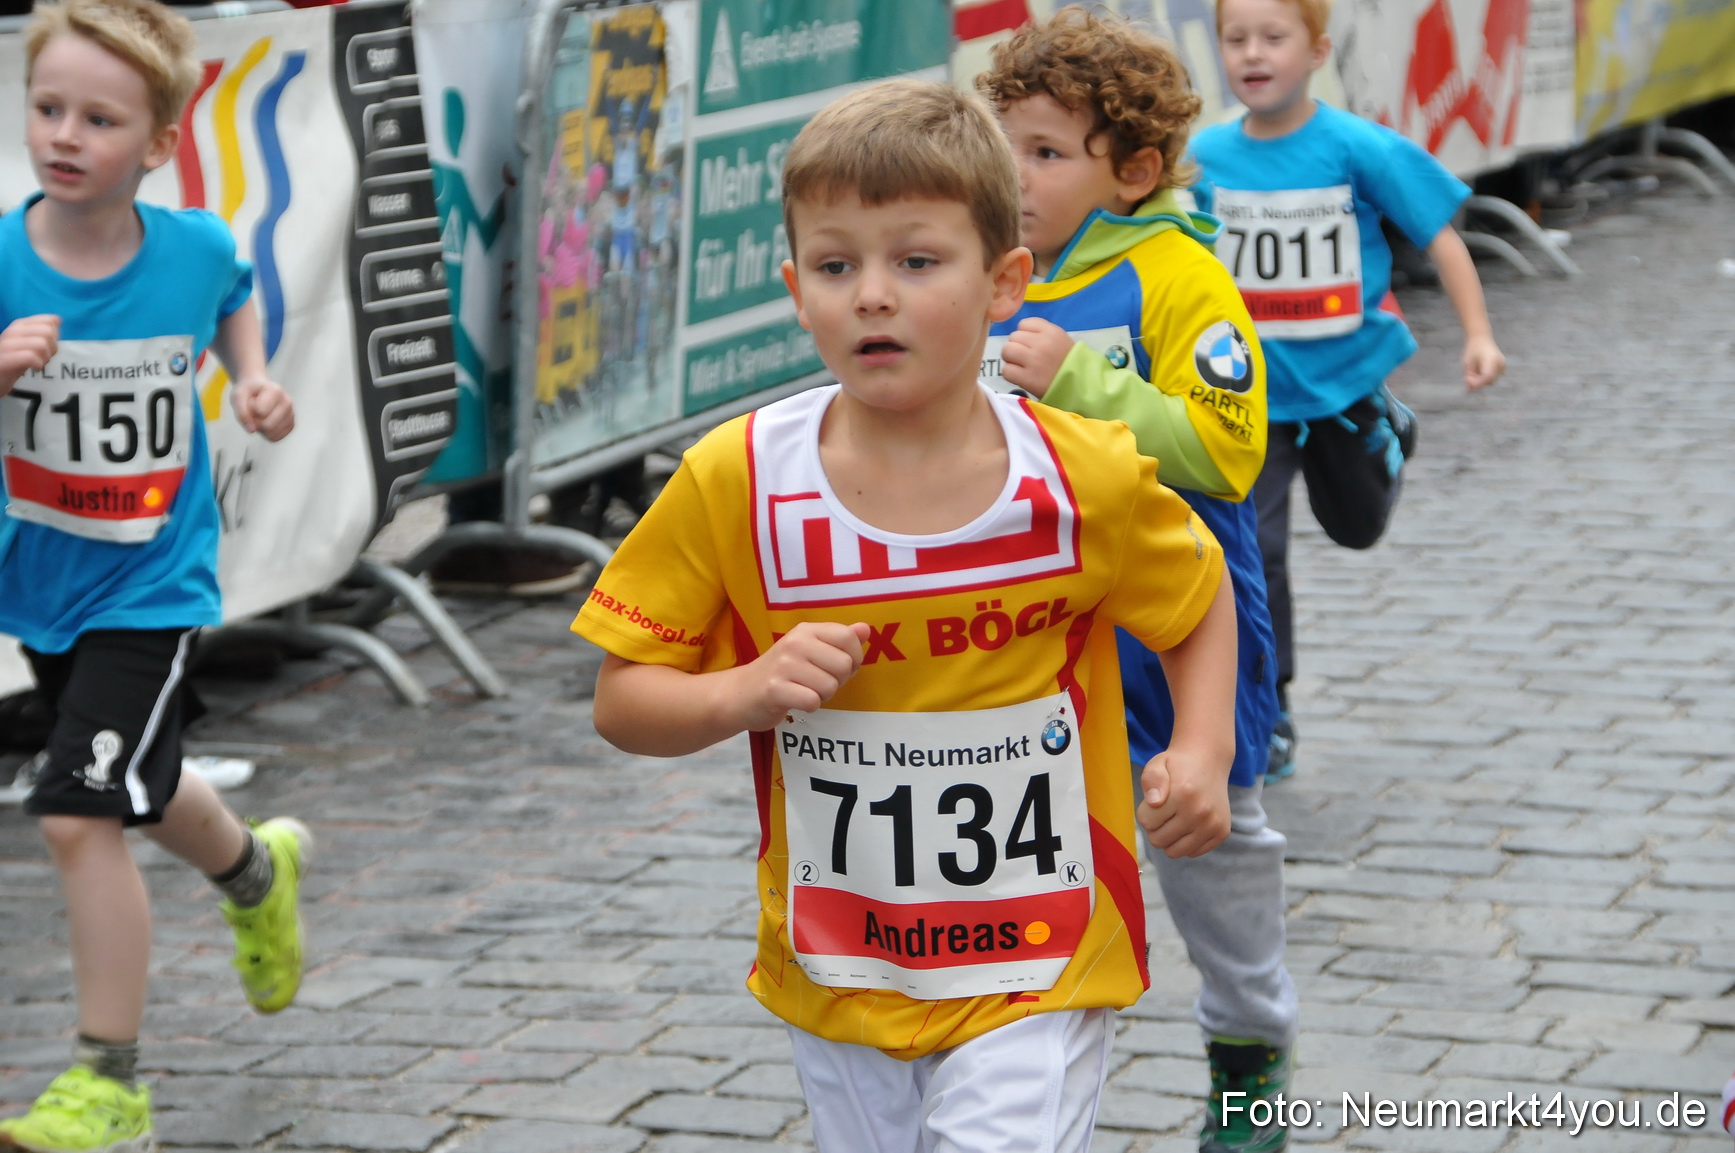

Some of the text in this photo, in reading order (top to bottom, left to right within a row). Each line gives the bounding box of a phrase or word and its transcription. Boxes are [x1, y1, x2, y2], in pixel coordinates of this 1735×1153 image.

[699, 147, 763, 216] Mehr
[1262, 203, 1336, 219] Neumarkt
[695, 238, 735, 302] für
[1227, 224, 1342, 280] 7011
[61, 360, 160, 380] Neumarkt
[9, 388, 175, 462] 7150
[1191, 385, 1254, 428] PARTL
[57, 482, 136, 512] Justin
[926, 597, 1074, 657] BÖGL
[782, 732, 1030, 768] PARTL Neumarkt
[809, 772, 1063, 887] 7134
[802, 864, 811, 881] 2
[1066, 865, 1078, 883] K
[864, 911, 1019, 958] Andreas
